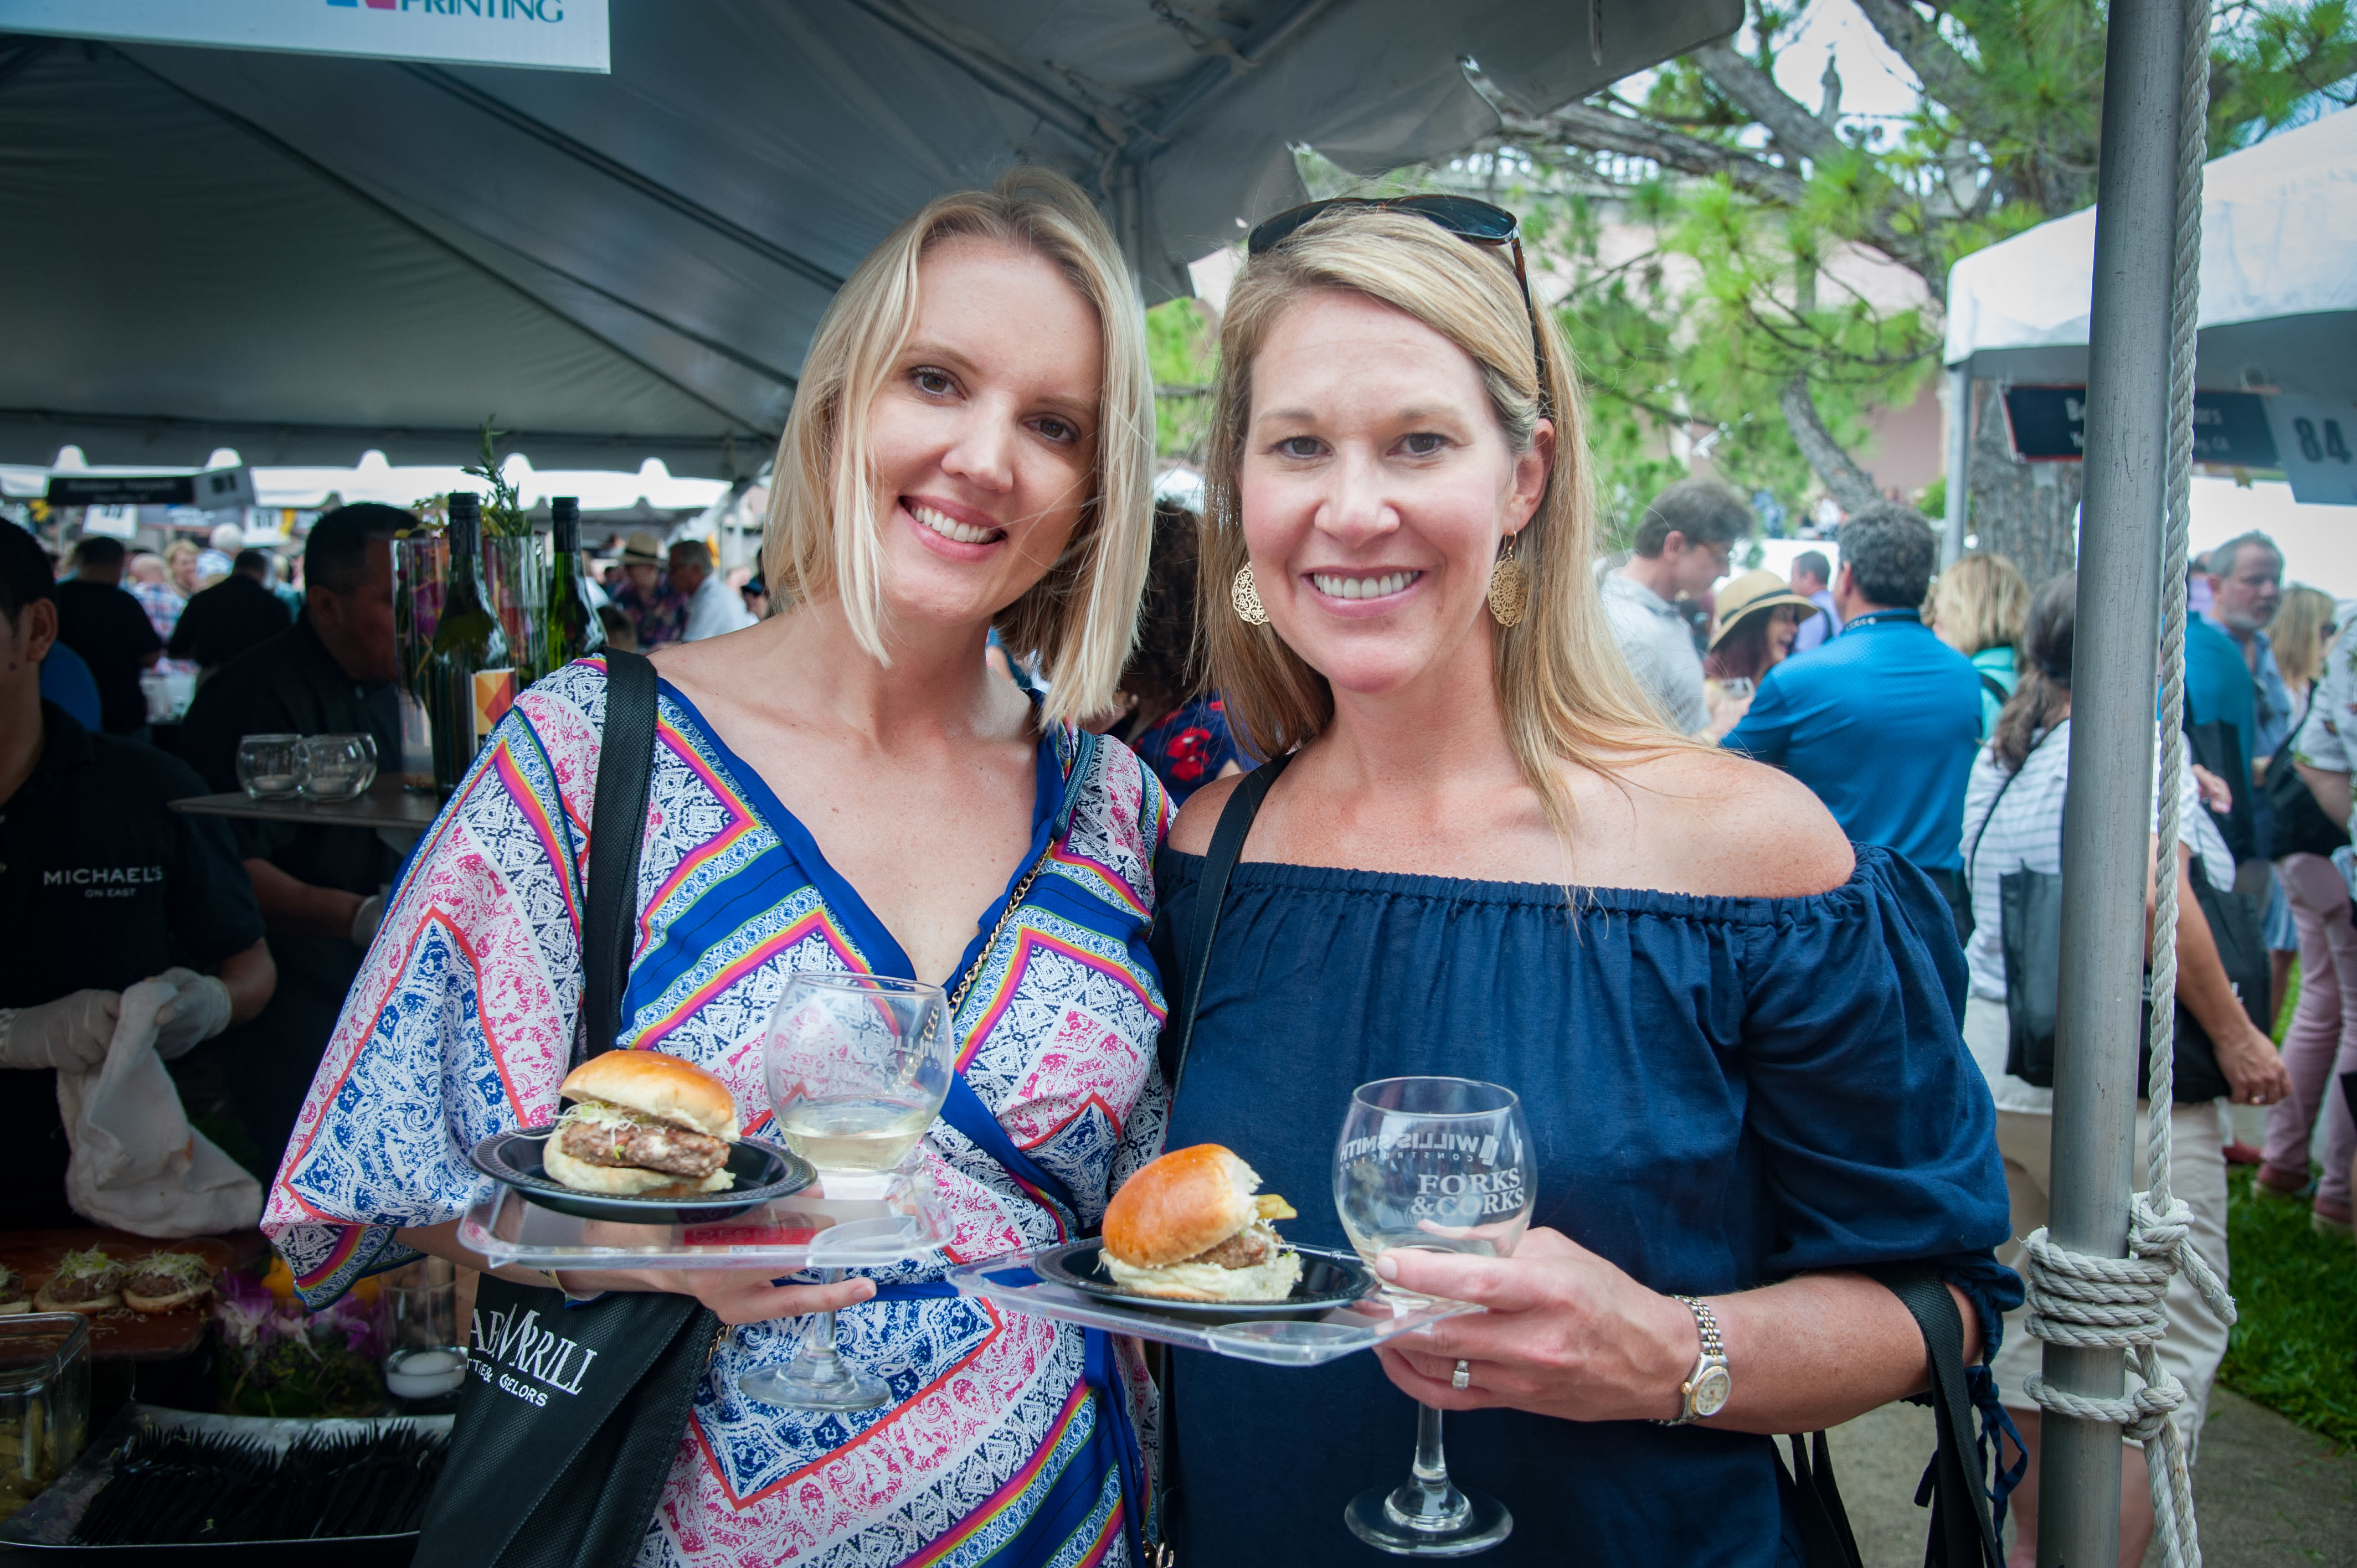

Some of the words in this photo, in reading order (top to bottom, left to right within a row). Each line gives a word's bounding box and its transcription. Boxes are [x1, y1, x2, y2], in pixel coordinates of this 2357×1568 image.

[2293, 417, 2353, 464] 84
[44, 865, 164, 886] MICHAEL'S
[84, 889, 103, 899] ON
[106, 887, 137, 899] EAST
[1417, 1167, 1521, 1196] FORKS
